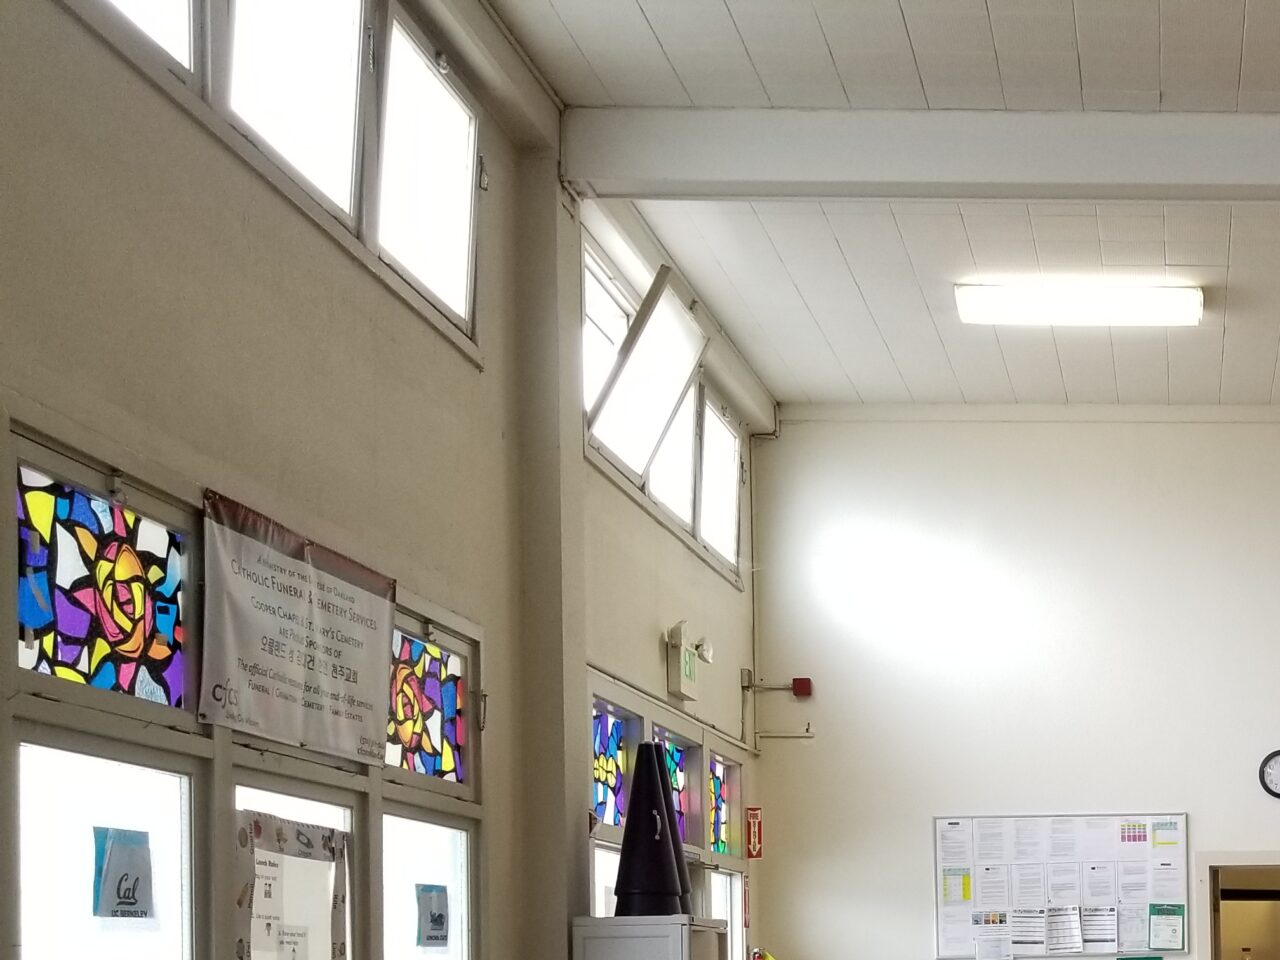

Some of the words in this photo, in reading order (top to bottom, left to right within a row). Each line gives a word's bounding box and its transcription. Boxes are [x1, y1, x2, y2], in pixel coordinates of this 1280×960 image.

[230, 558, 270, 589] CATHOLIC
[270, 575, 306, 601] FUNERA
[316, 597, 348, 620] EMETERY
[348, 607, 378, 631] SERVICES
[250, 595, 277, 617] COOPER
[237, 657, 249, 672] The
[333, 648, 343, 660] OF
[684, 650, 696, 681] EXIT
[116, 872, 139, 906] Cal
